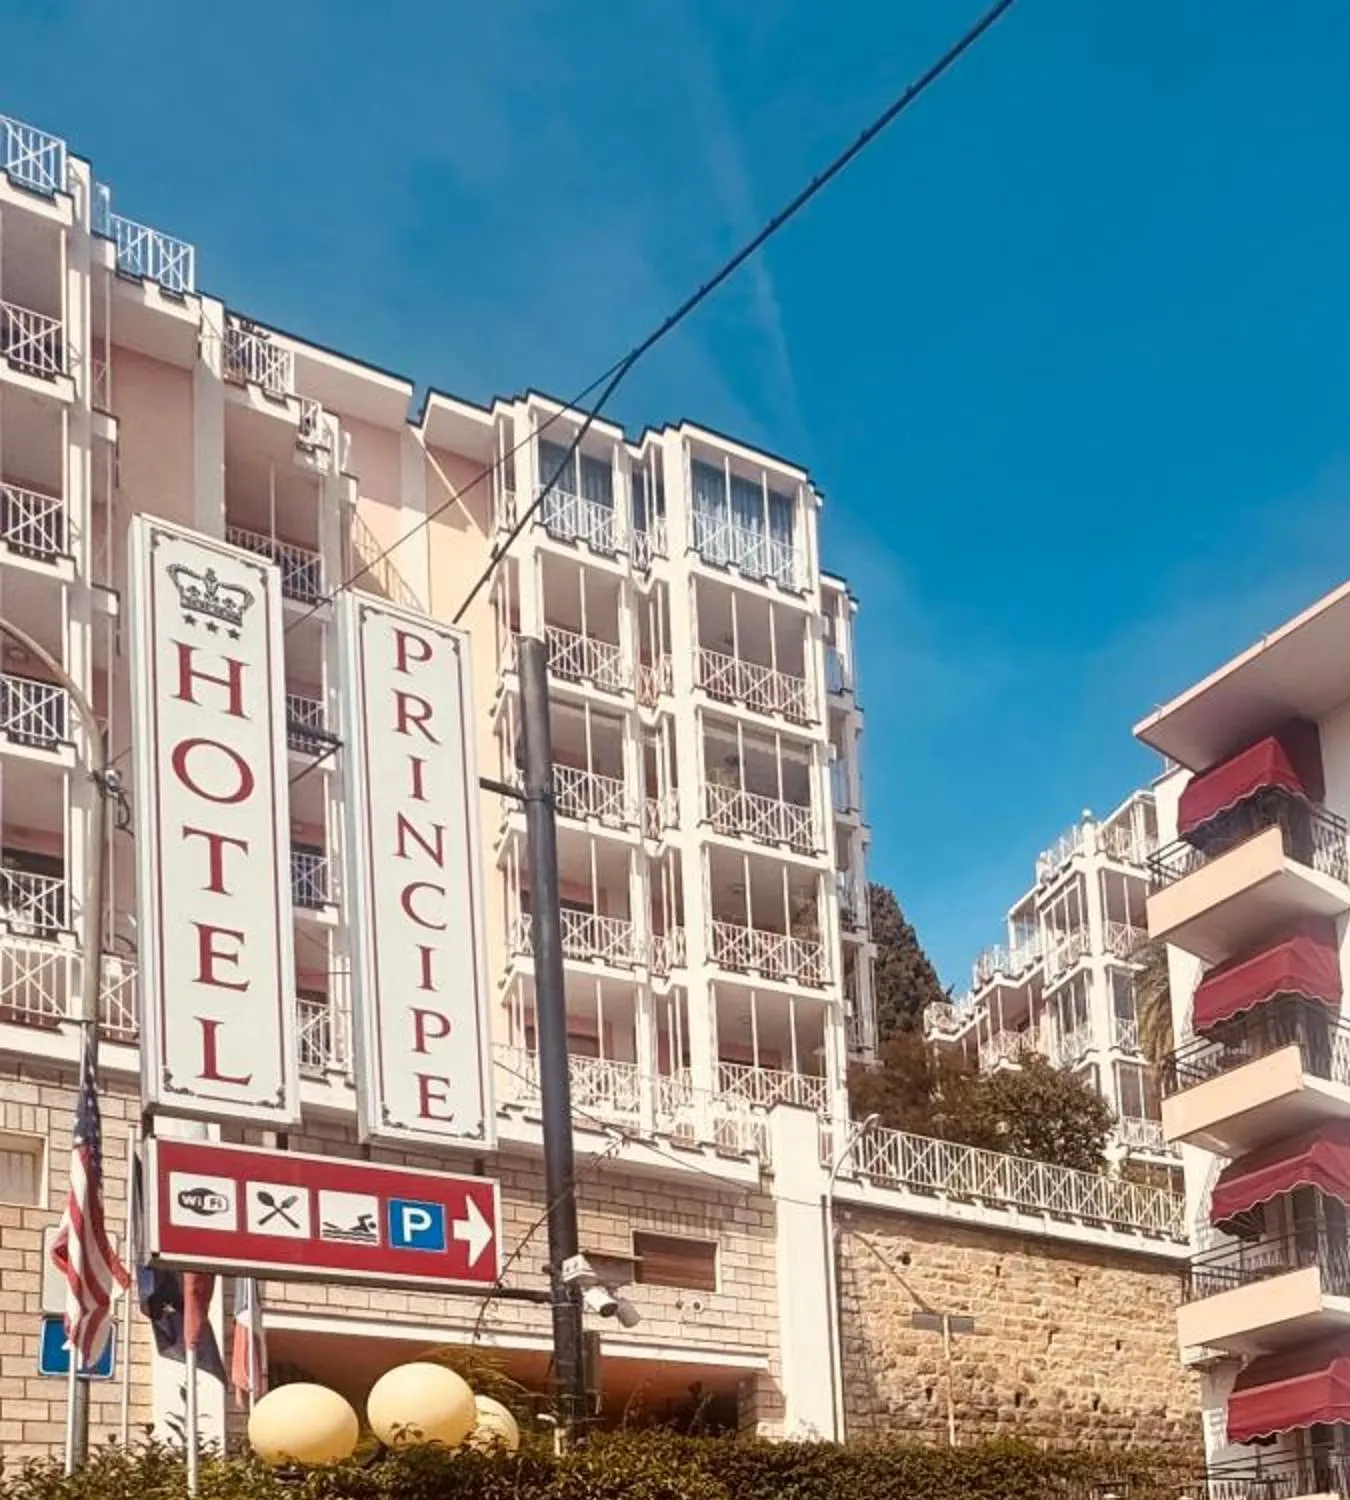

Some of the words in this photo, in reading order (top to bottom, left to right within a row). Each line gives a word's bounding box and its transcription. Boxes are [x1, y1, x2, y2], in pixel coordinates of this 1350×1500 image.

[171, 641, 256, 1086] HOTEL
[392, 628, 454, 1122] PRINCIPE
[402, 1207, 432, 1242] P
